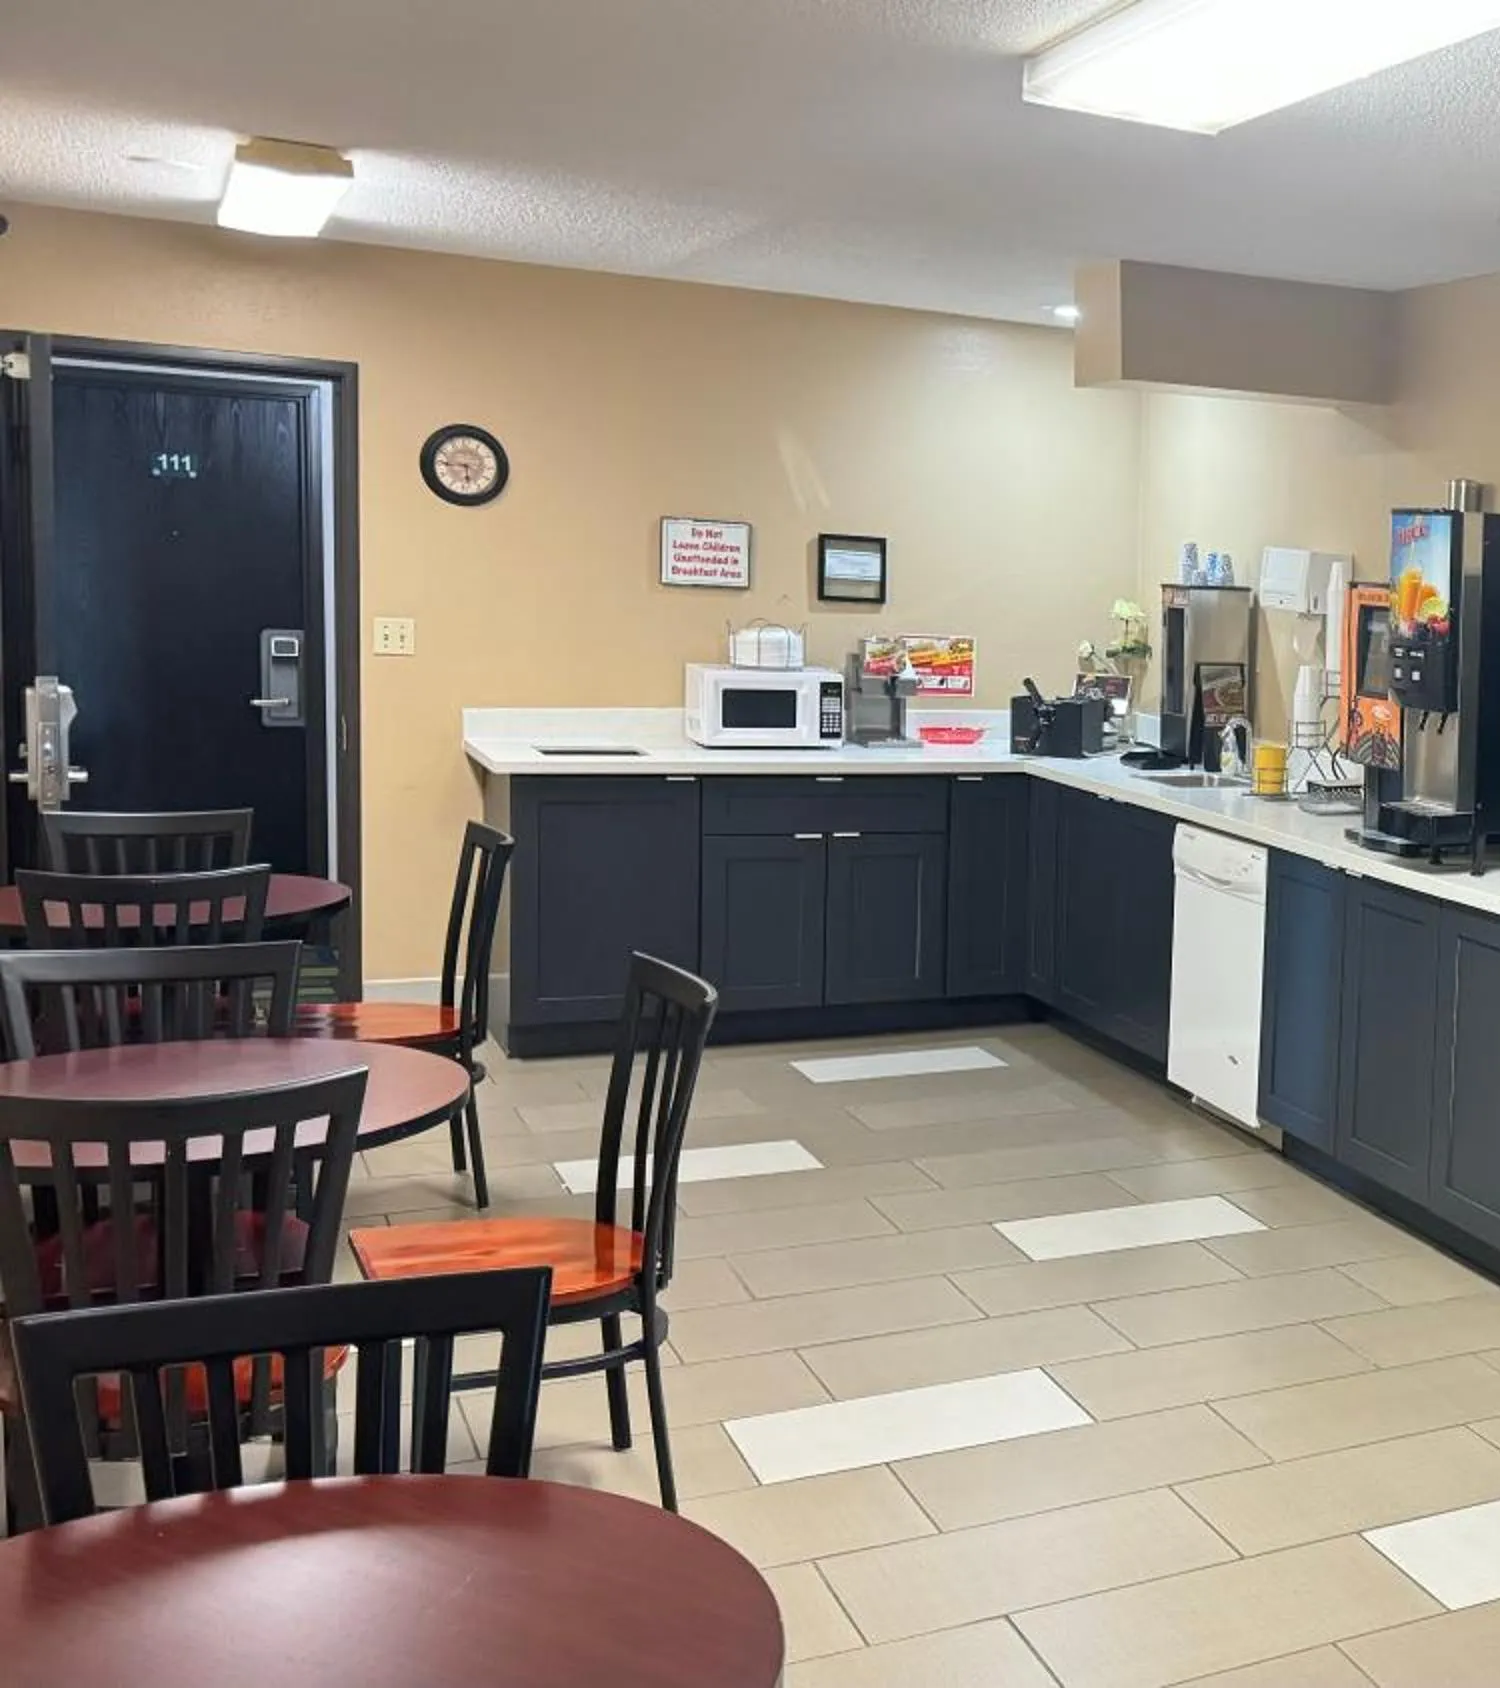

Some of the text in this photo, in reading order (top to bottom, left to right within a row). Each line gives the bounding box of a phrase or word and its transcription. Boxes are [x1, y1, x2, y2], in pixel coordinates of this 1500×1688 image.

[157, 453, 191, 471] 111
[705, 529, 723, 539] Not
[672, 540, 741, 553] Leave Children
[673, 553, 729, 565] Unattended
[671, 565, 742, 578] Breakfast Area
